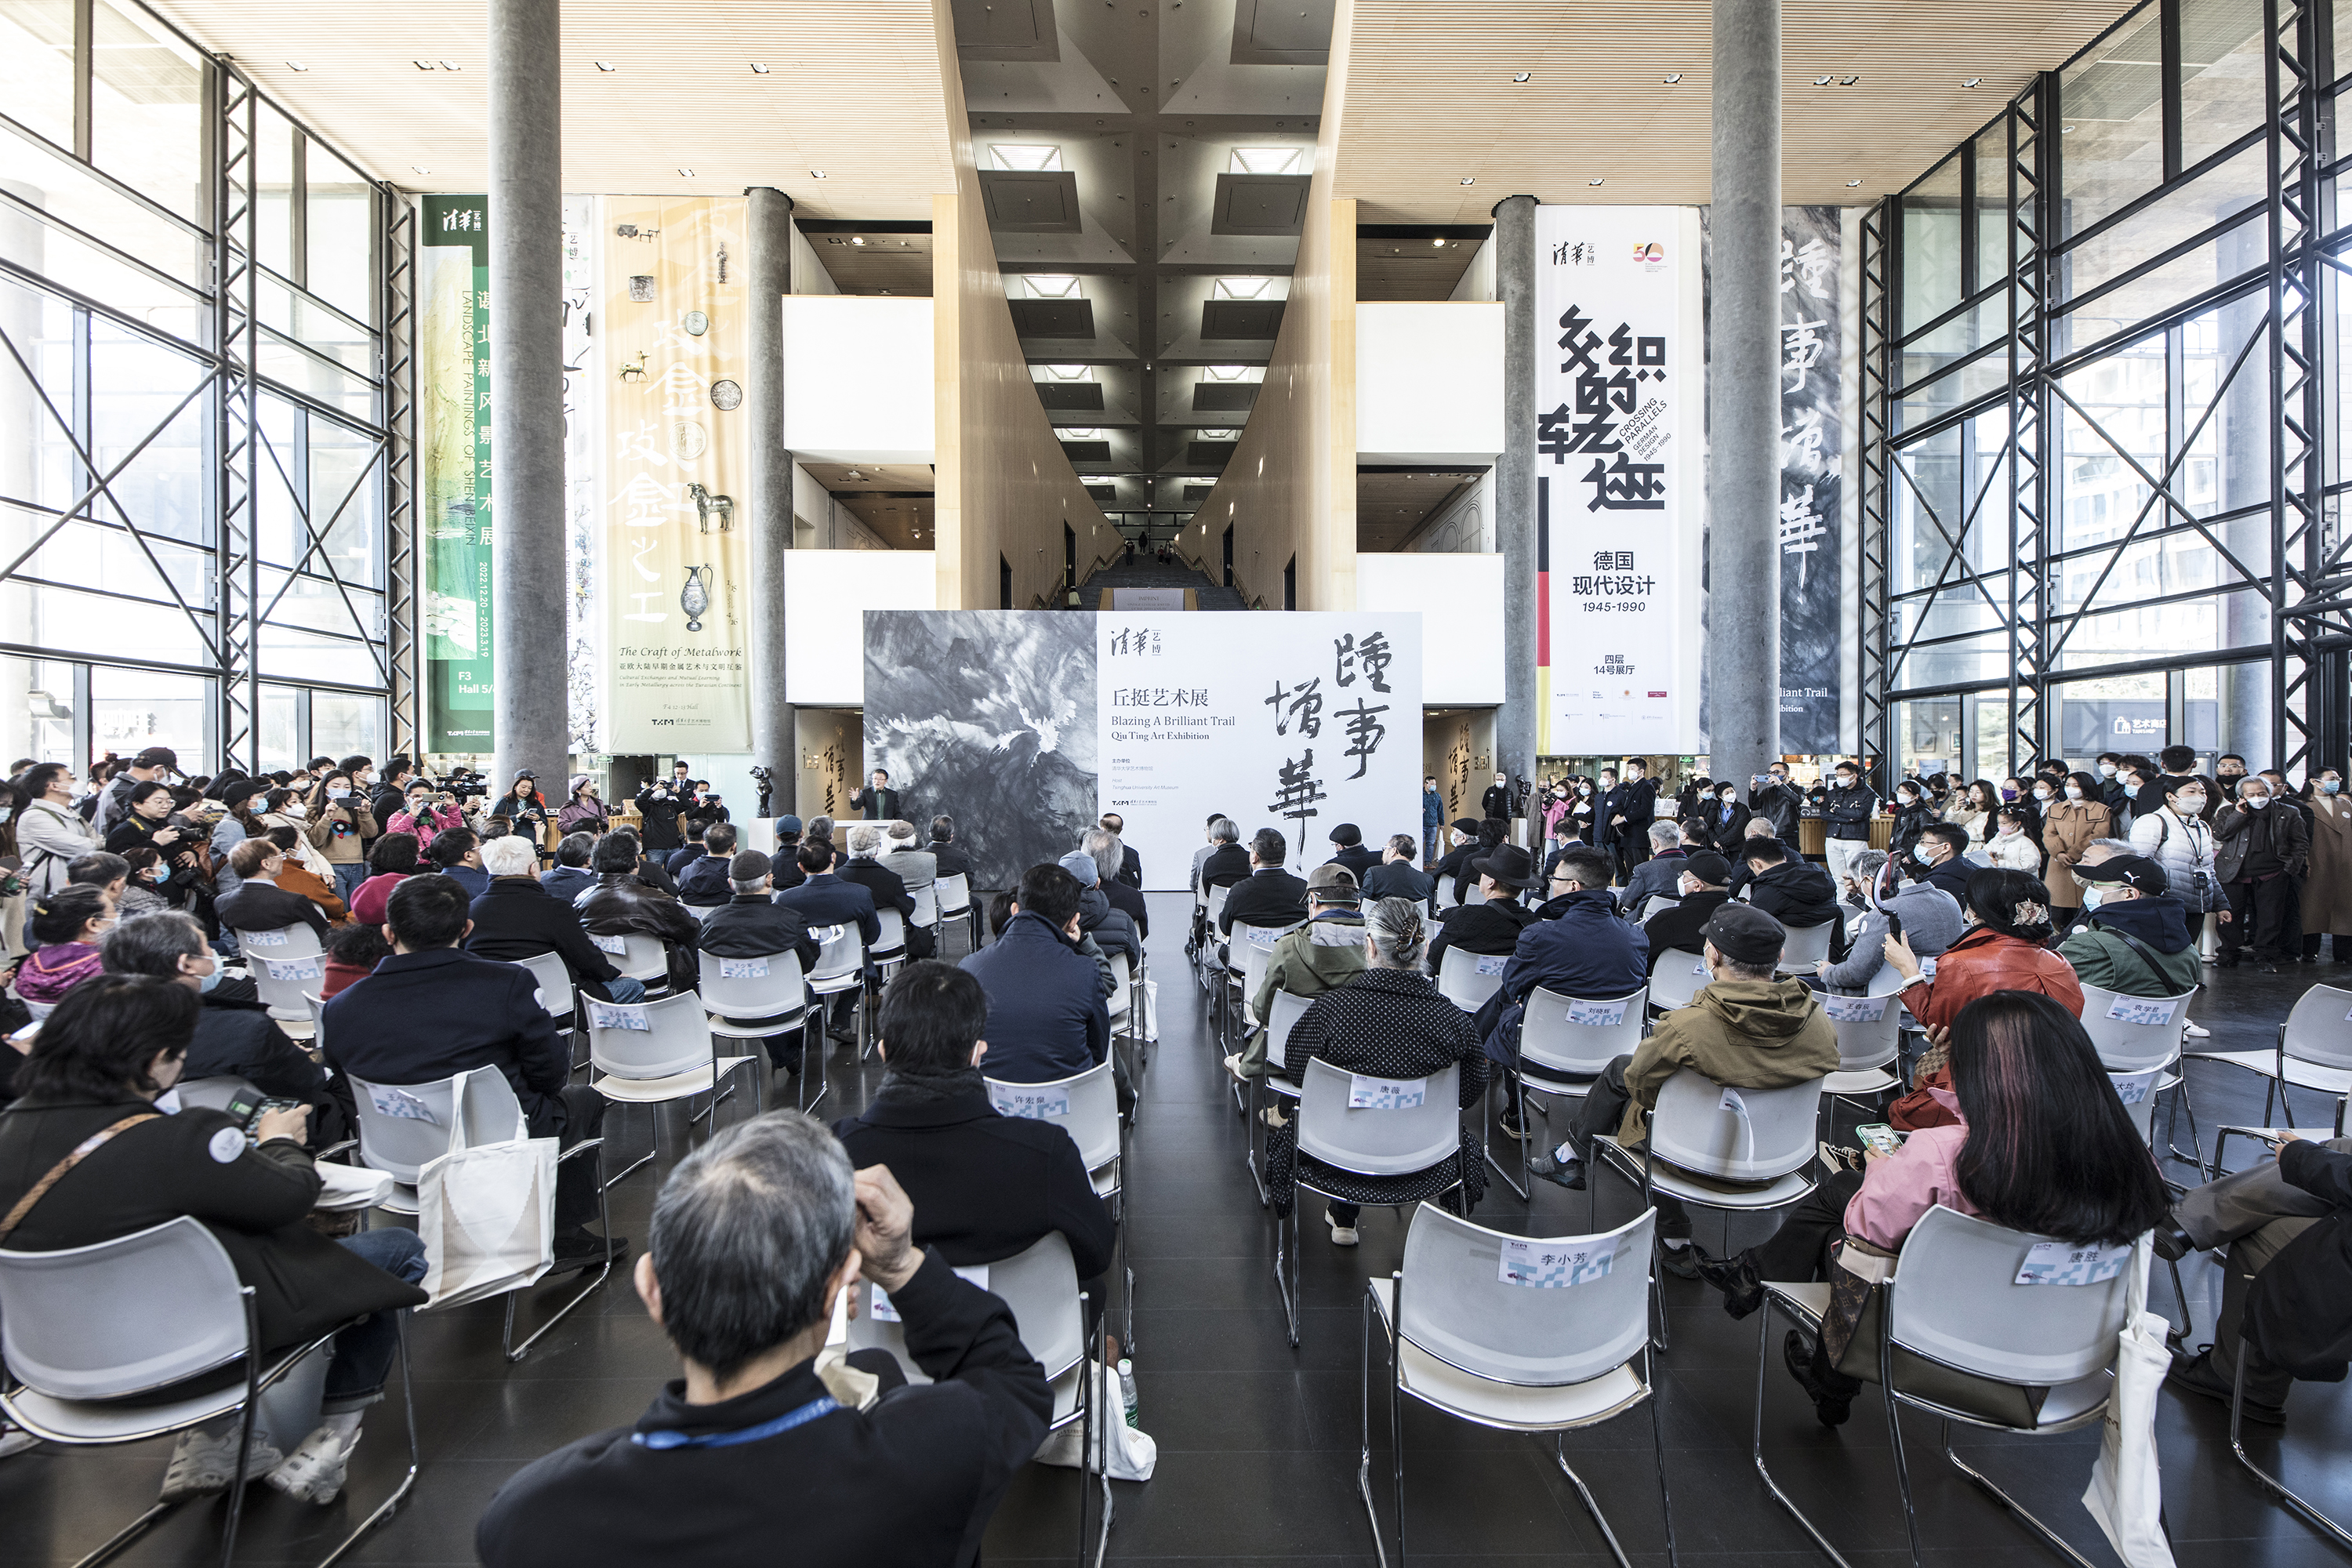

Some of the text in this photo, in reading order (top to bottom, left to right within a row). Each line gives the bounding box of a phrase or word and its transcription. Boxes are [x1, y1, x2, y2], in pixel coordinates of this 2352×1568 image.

[462, 291, 476, 546] LANDSCAPE PAINTINGS OF SHEN BEIXIN
[1620, 398, 1657, 437] CROSSING
[1624, 401, 1667, 444] PARALLELS
[1633, 425, 1658, 450] GERMAN
[1638, 434, 1659, 456] DESIGN
[1594, 550, 1634, 571] 德国
[479, 562, 488, 607] 2022.12.20
[1573, 575, 1656, 596] 现代设计
[1582, 602, 1646, 612] 1945-1990
[480, 617, 488, 657] 2023.3.19
[619, 647, 742, 659] The Craft of Metalwork
[1605, 655, 1624, 664] 四层
[458, 671, 471, 681] F3
[1593, 665, 1635, 675] 14号展厅
[459, 684, 494, 695] Hall 5/
[1804, 688, 1828, 697] Trail
[1112, 688, 1208, 706] 丘挺艺术展
[1112, 716, 1235, 728] Blazing A Brilliant Trail
[2132, 719, 2166, 728] 艺术商店
[1112, 731, 1210, 742] Qiu Ting Art Exhibition
[1541, 1252, 1588, 1265] 李小芳
